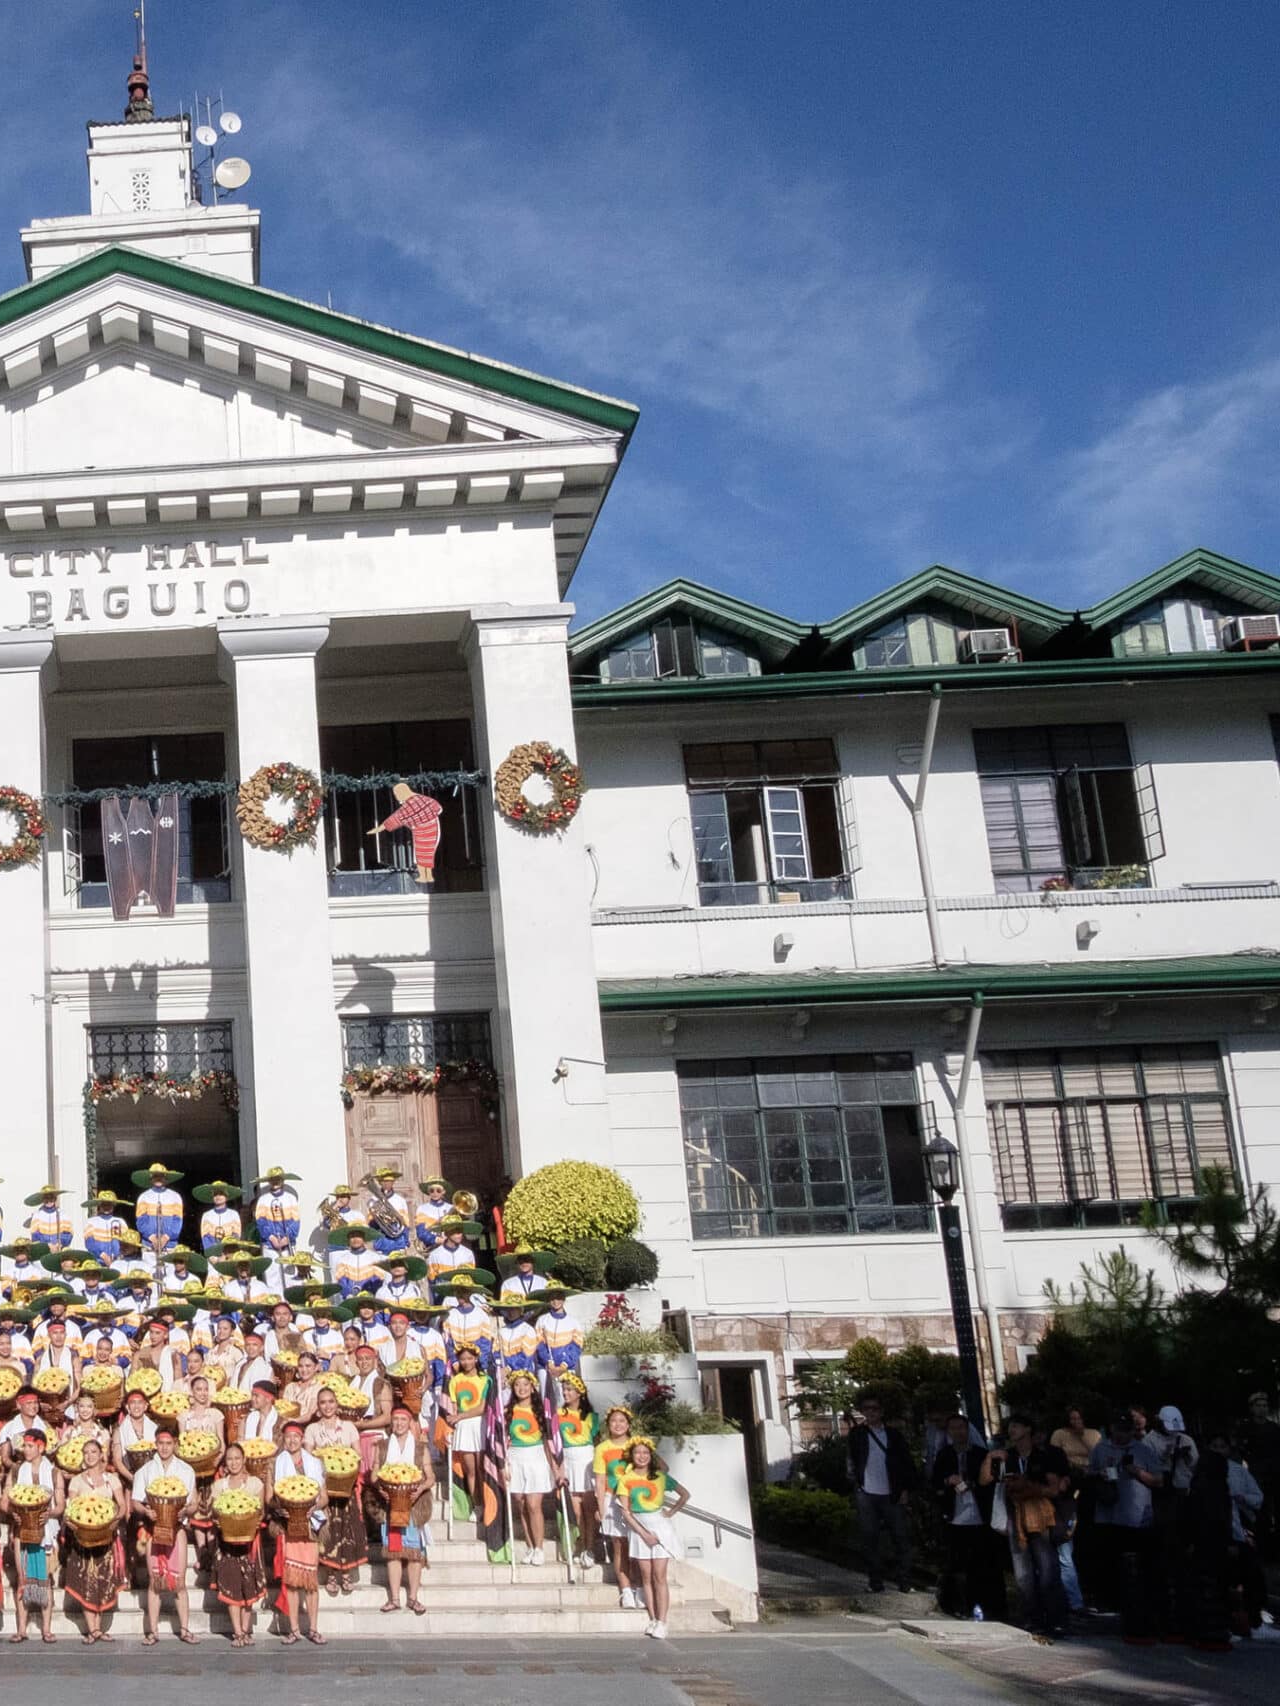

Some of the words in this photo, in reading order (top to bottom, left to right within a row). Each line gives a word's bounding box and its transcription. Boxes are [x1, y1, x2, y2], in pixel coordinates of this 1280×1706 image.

[9, 546, 113, 578] CITY
[145, 538, 269, 571] HALL
[27, 578, 250, 624] BAGUIO
